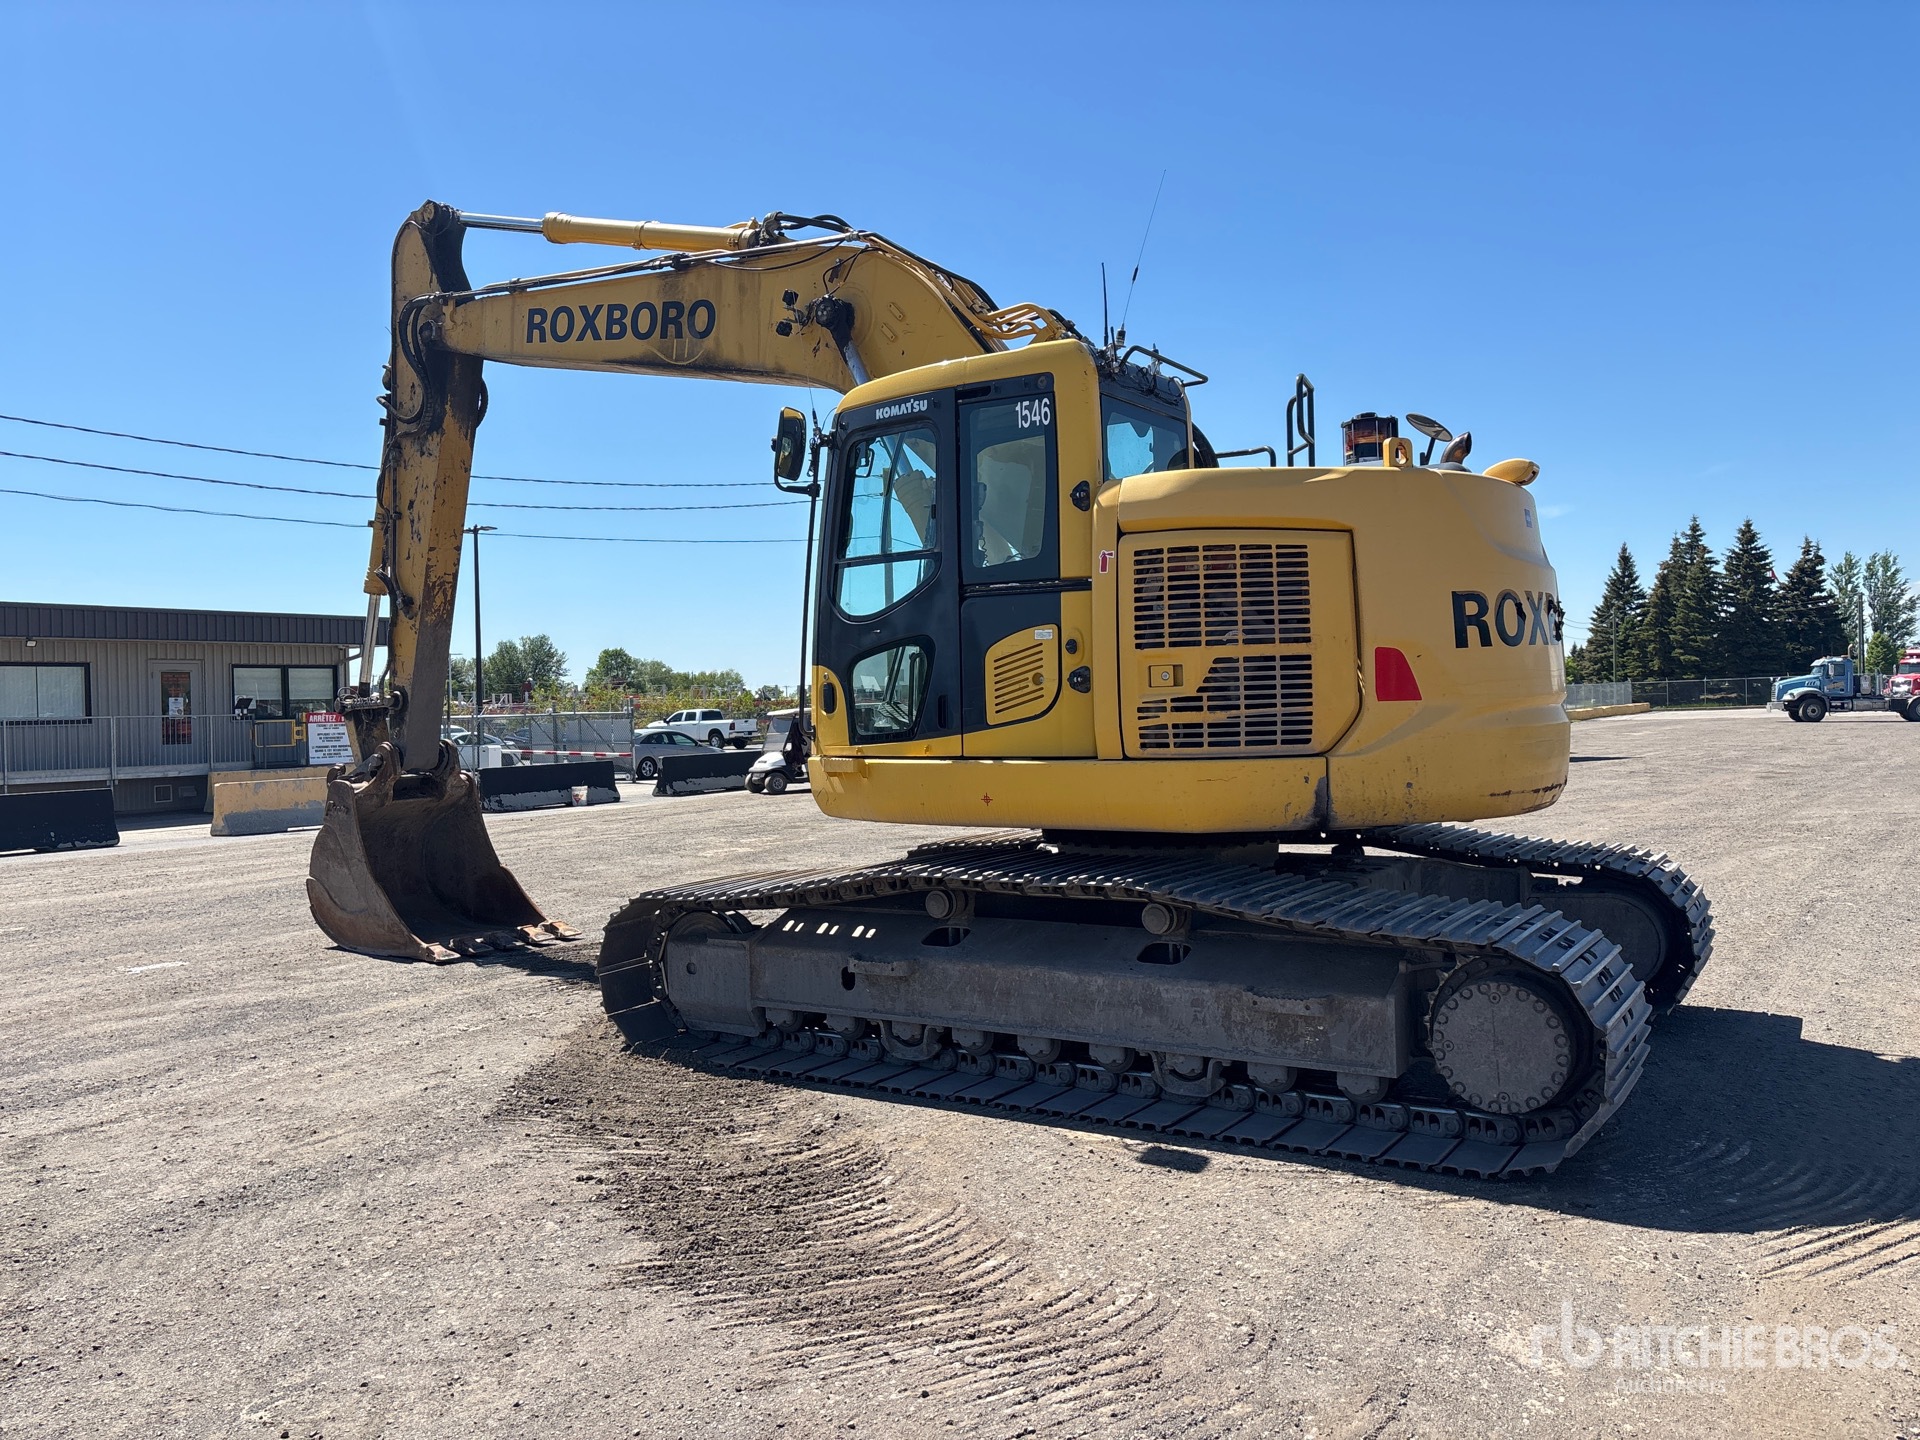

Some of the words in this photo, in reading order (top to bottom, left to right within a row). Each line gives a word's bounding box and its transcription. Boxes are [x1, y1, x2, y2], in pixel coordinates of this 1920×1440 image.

[526, 299, 716, 344] ROXBORO
[875, 398, 928, 420] KOMATSU
[1015, 397, 1050, 429] 1546
[308, 713, 337, 723] ARRÊTEZ
